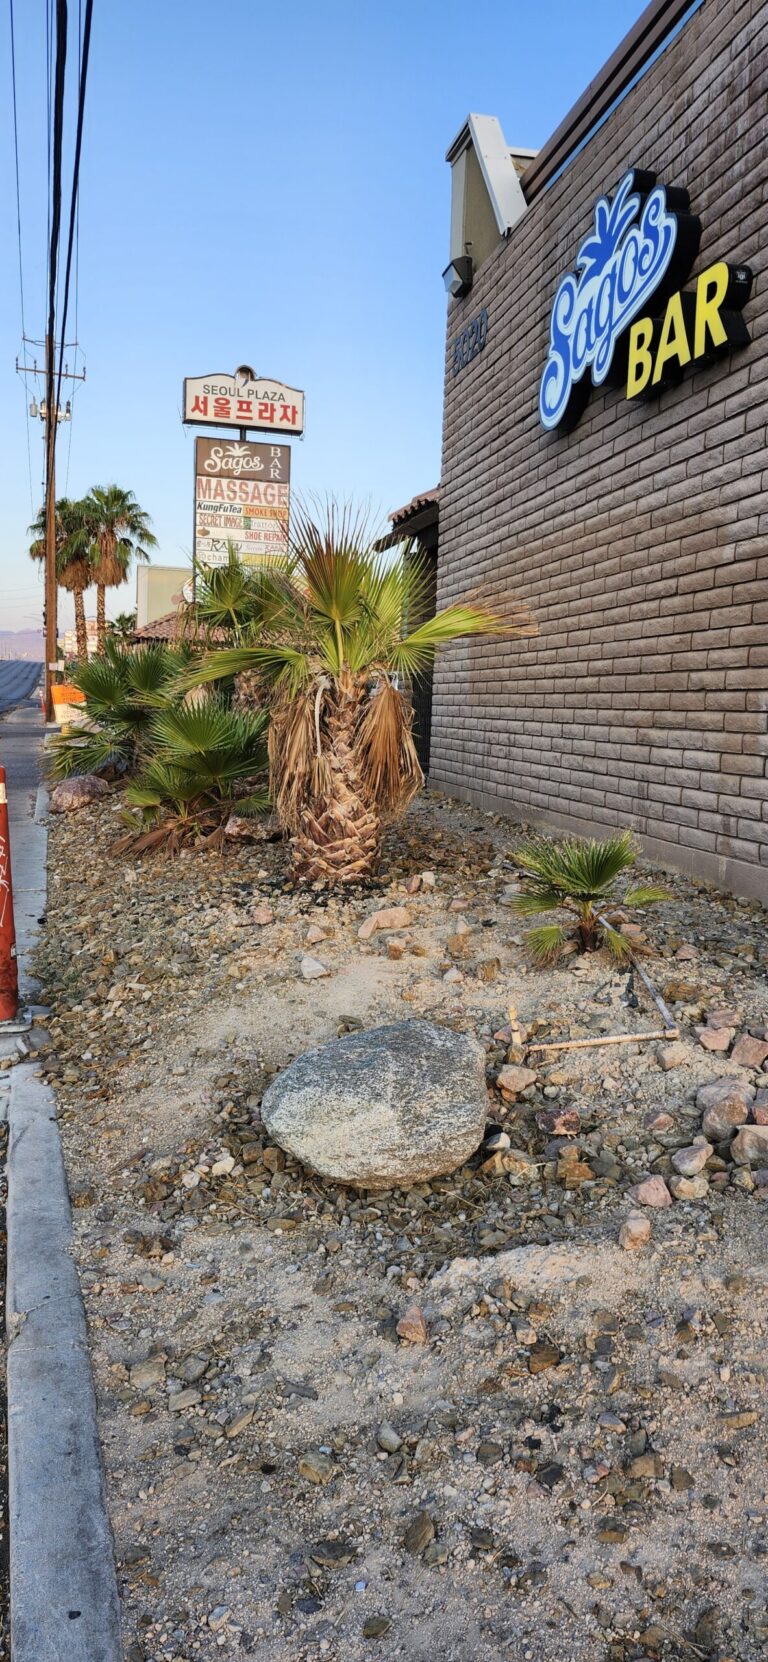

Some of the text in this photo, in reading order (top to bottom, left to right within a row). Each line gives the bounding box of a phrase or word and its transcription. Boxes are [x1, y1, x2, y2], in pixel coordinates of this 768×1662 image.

[541, 187, 676, 427] Sagos
[626, 261, 728, 400] BAR
[203, 384, 286, 402] SEOUL PLAZA
[191, 395, 298, 425] 서울프라자
[203, 446, 264, 476] Sagos
[269, 446, 282, 479] BAR
[196, 478, 288, 507] MASSAGE
[199, 514, 243, 528] SECRET IMAGE
[245, 507, 267, 517] SMOKE
[244, 531, 262, 540] SHOE
